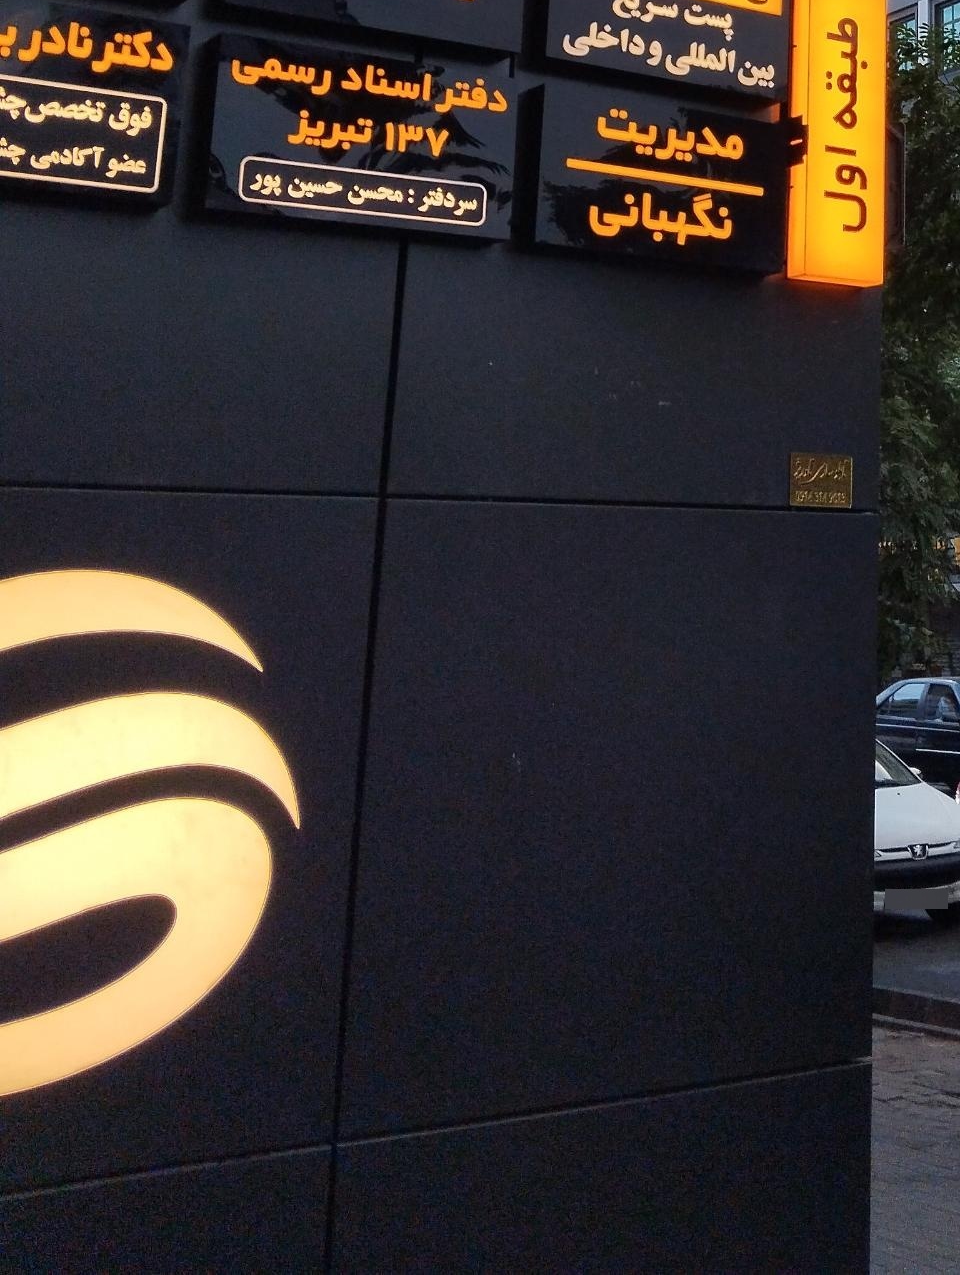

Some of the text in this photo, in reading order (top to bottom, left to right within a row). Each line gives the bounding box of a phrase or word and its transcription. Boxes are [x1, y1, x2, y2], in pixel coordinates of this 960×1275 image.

[18, 21, 92, 62] نادر
[683, 4, 733, 41] پست
[91, 31, 173, 72] دکتر
[562, 21, 775, 88] بین المللی و داخلی
[231, 57, 509, 113] دفتر اسناد رسمی
[25, 99, 152, 137] فوق تخصص
[287, 109, 373, 150] تبریز
[597, 108, 744, 162] مدیریت
[824, 17, 868, 233] طبقه اول
[30, 146, 146, 178] عضو آکادمی
[287, 176, 343, 198] حسین
[347, 184, 404, 205] محسن
[589, 192, 733, 247] نگهبانی
